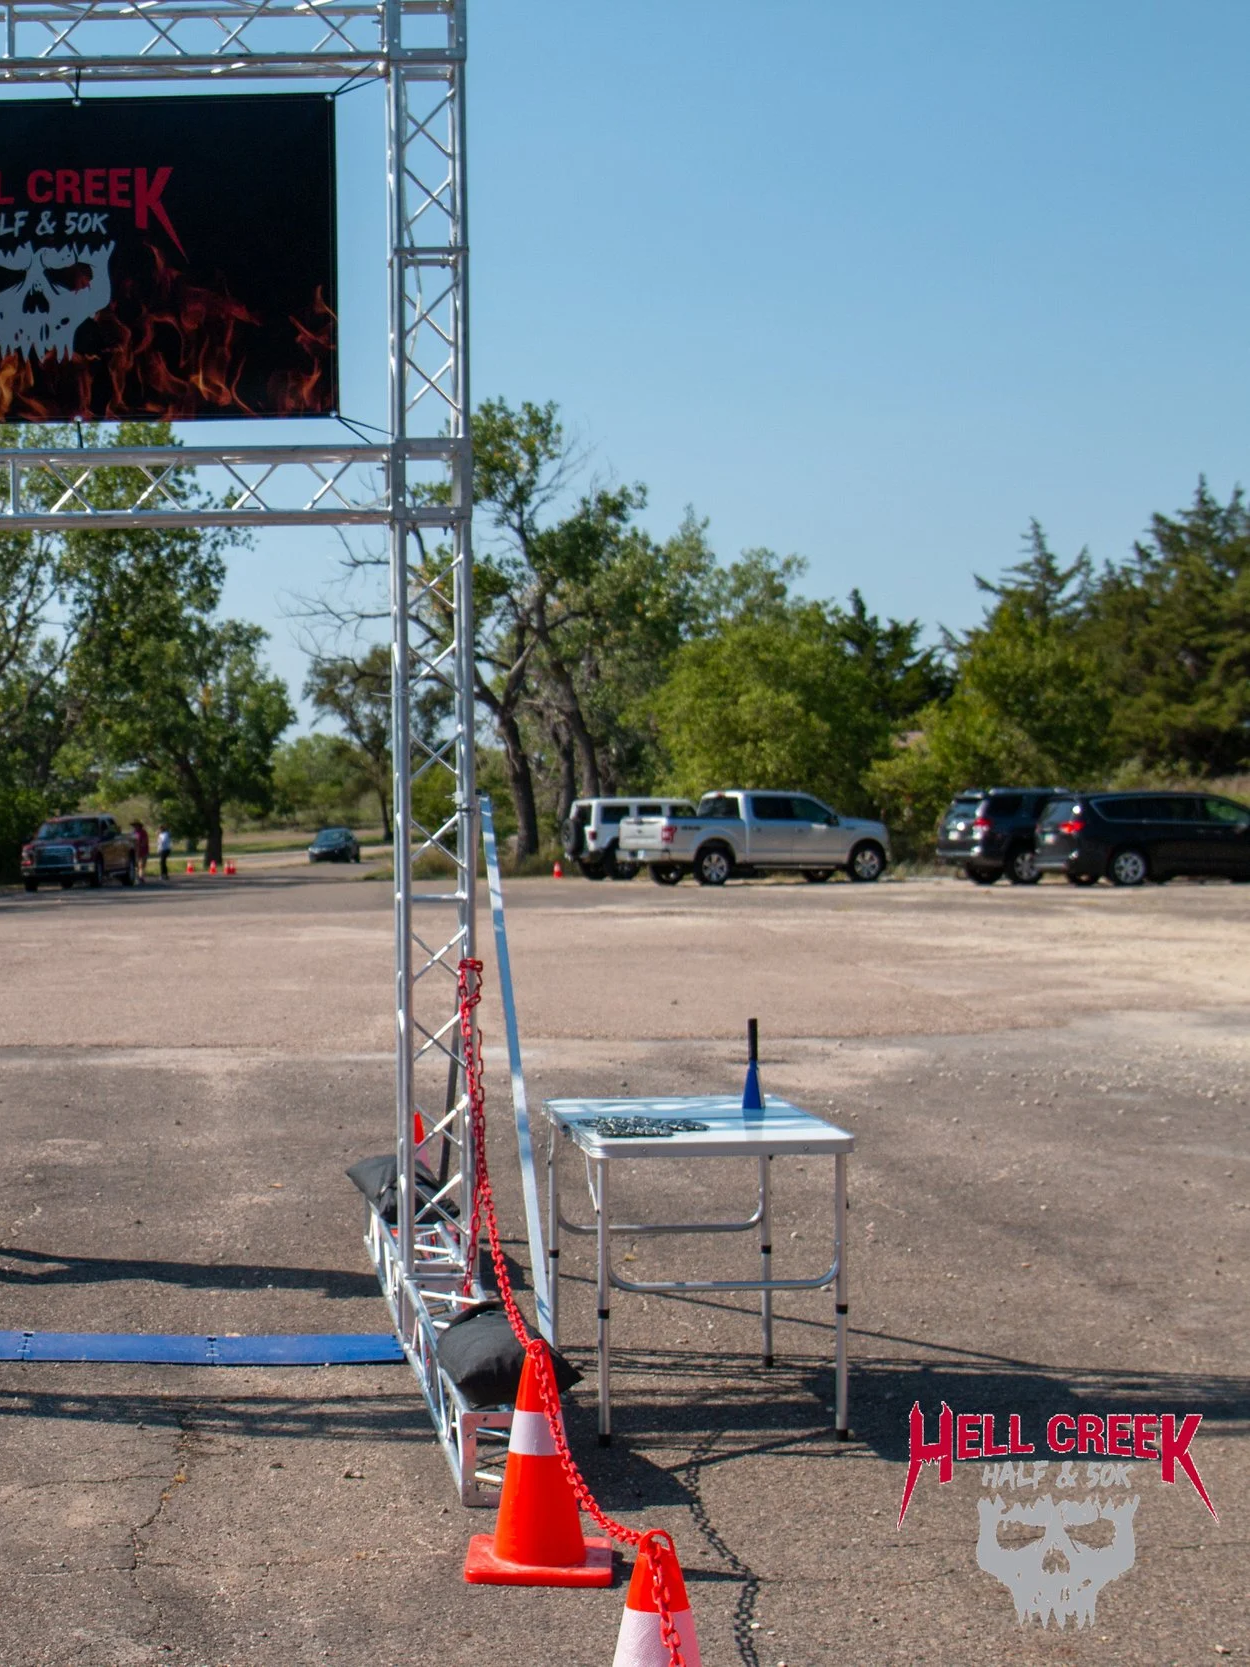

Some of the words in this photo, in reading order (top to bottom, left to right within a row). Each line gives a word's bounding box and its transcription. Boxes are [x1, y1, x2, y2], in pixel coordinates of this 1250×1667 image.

[26, 166, 189, 263] CREEK
[35, 210, 57, 236] &
[64, 211, 109, 235] 50K
